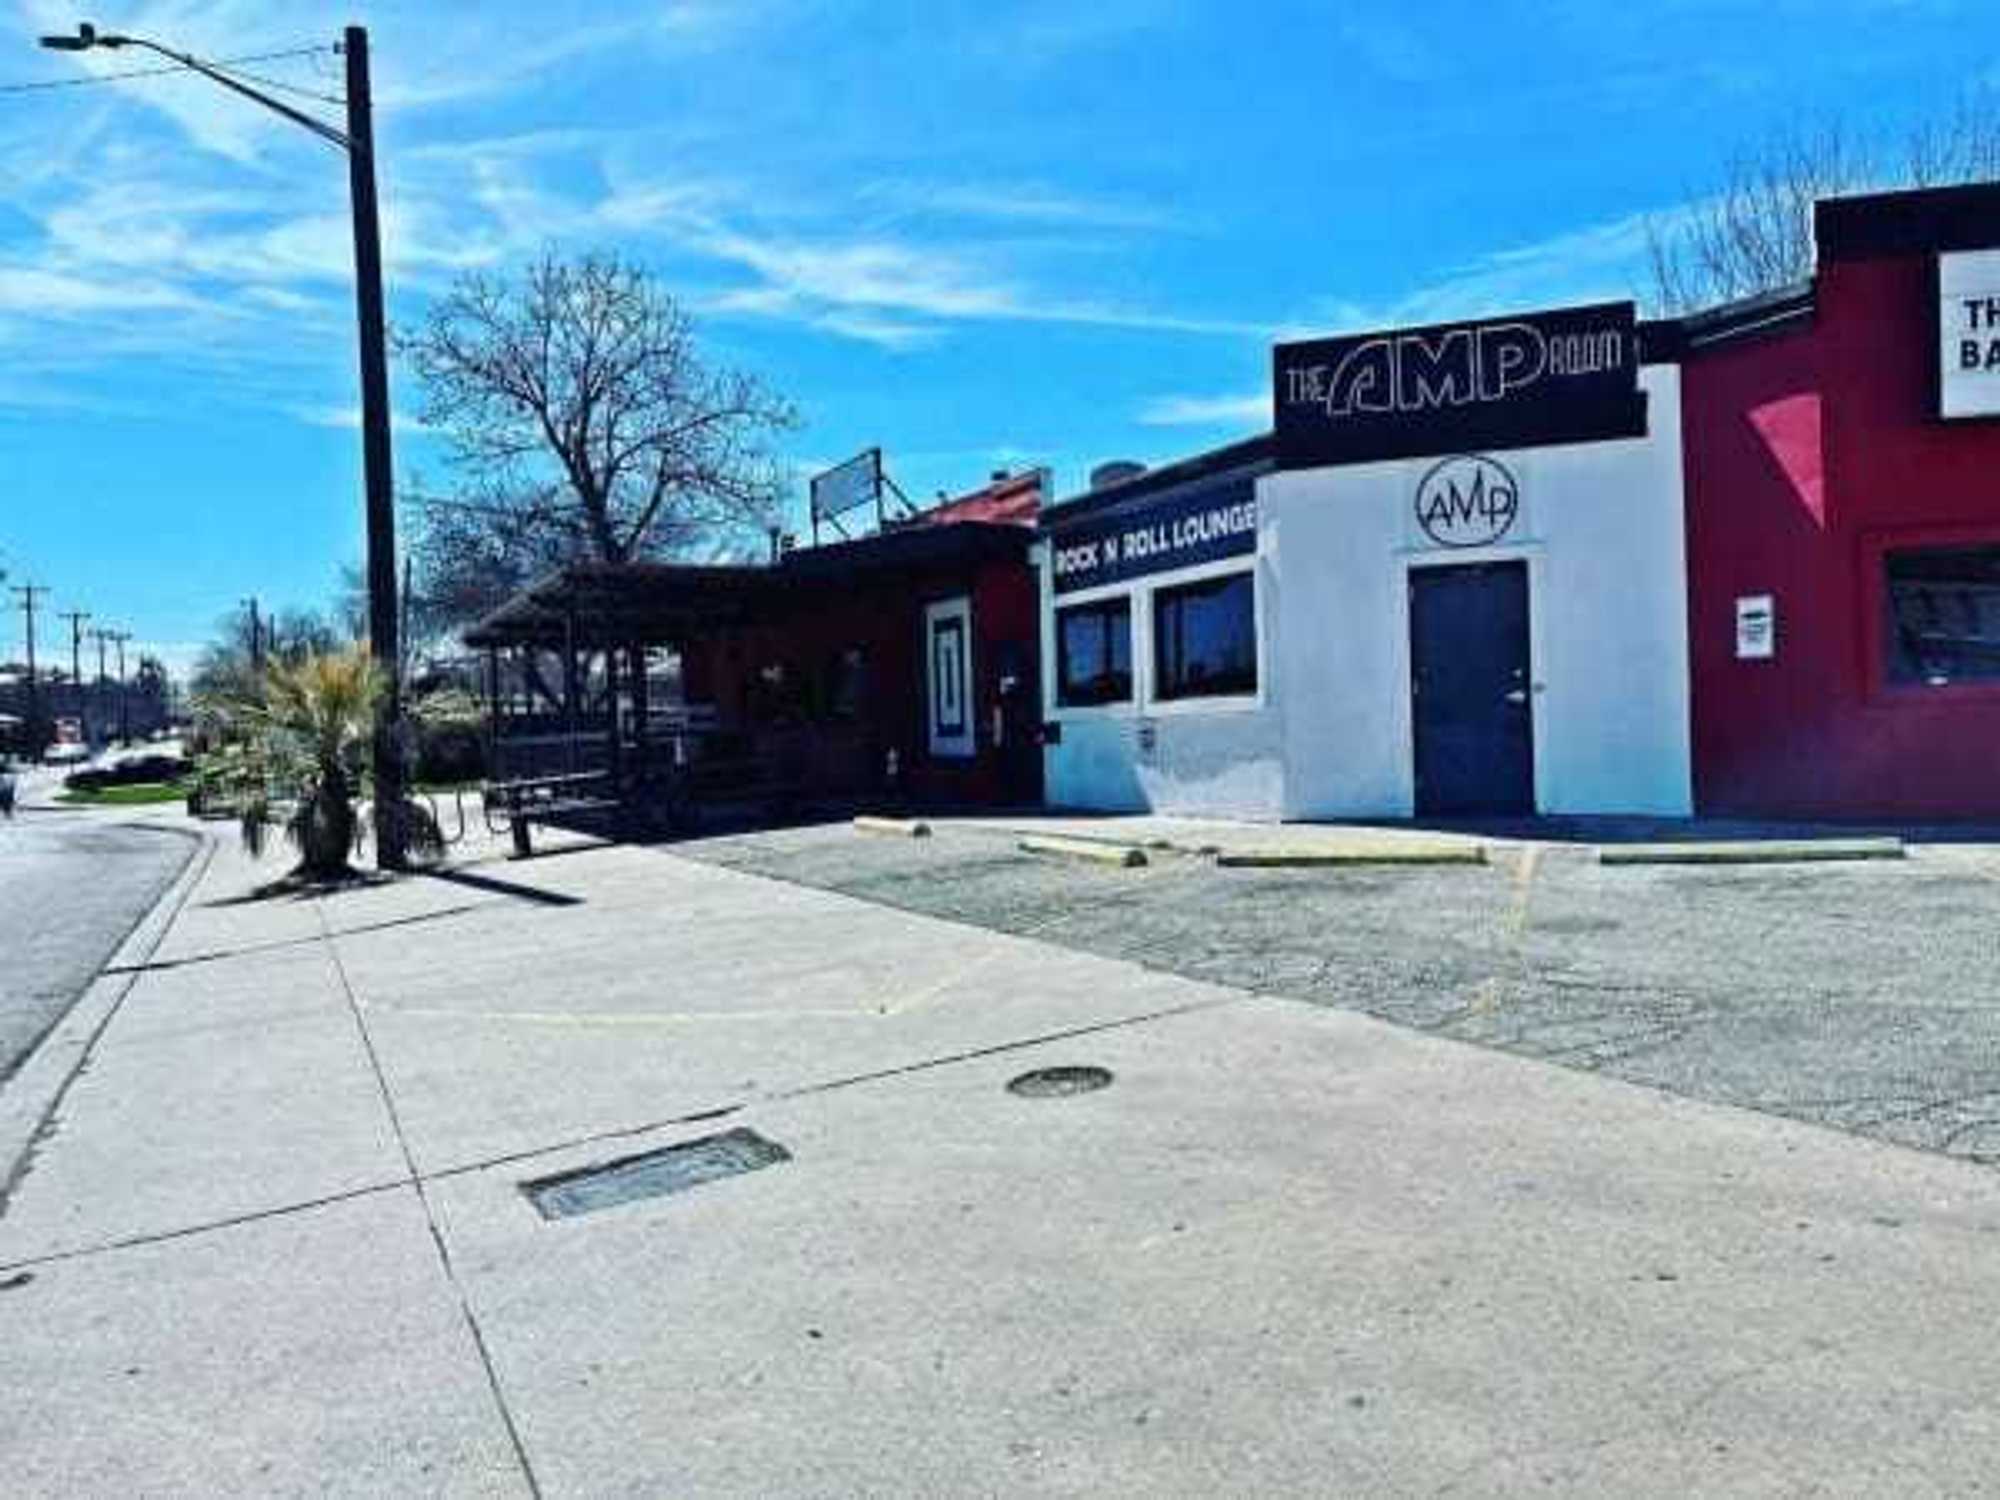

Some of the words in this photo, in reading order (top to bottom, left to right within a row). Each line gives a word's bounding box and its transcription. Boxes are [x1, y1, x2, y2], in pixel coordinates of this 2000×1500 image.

[1286, 364, 1329, 402] THE
[1327, 323, 1548, 416] AMP
[1549, 331, 1622, 375] ROOM
[1425, 464, 1513, 529] AMP
[1122, 522, 1171, 562] ROLL
[1172, 502, 1257, 549] LOUNGE
